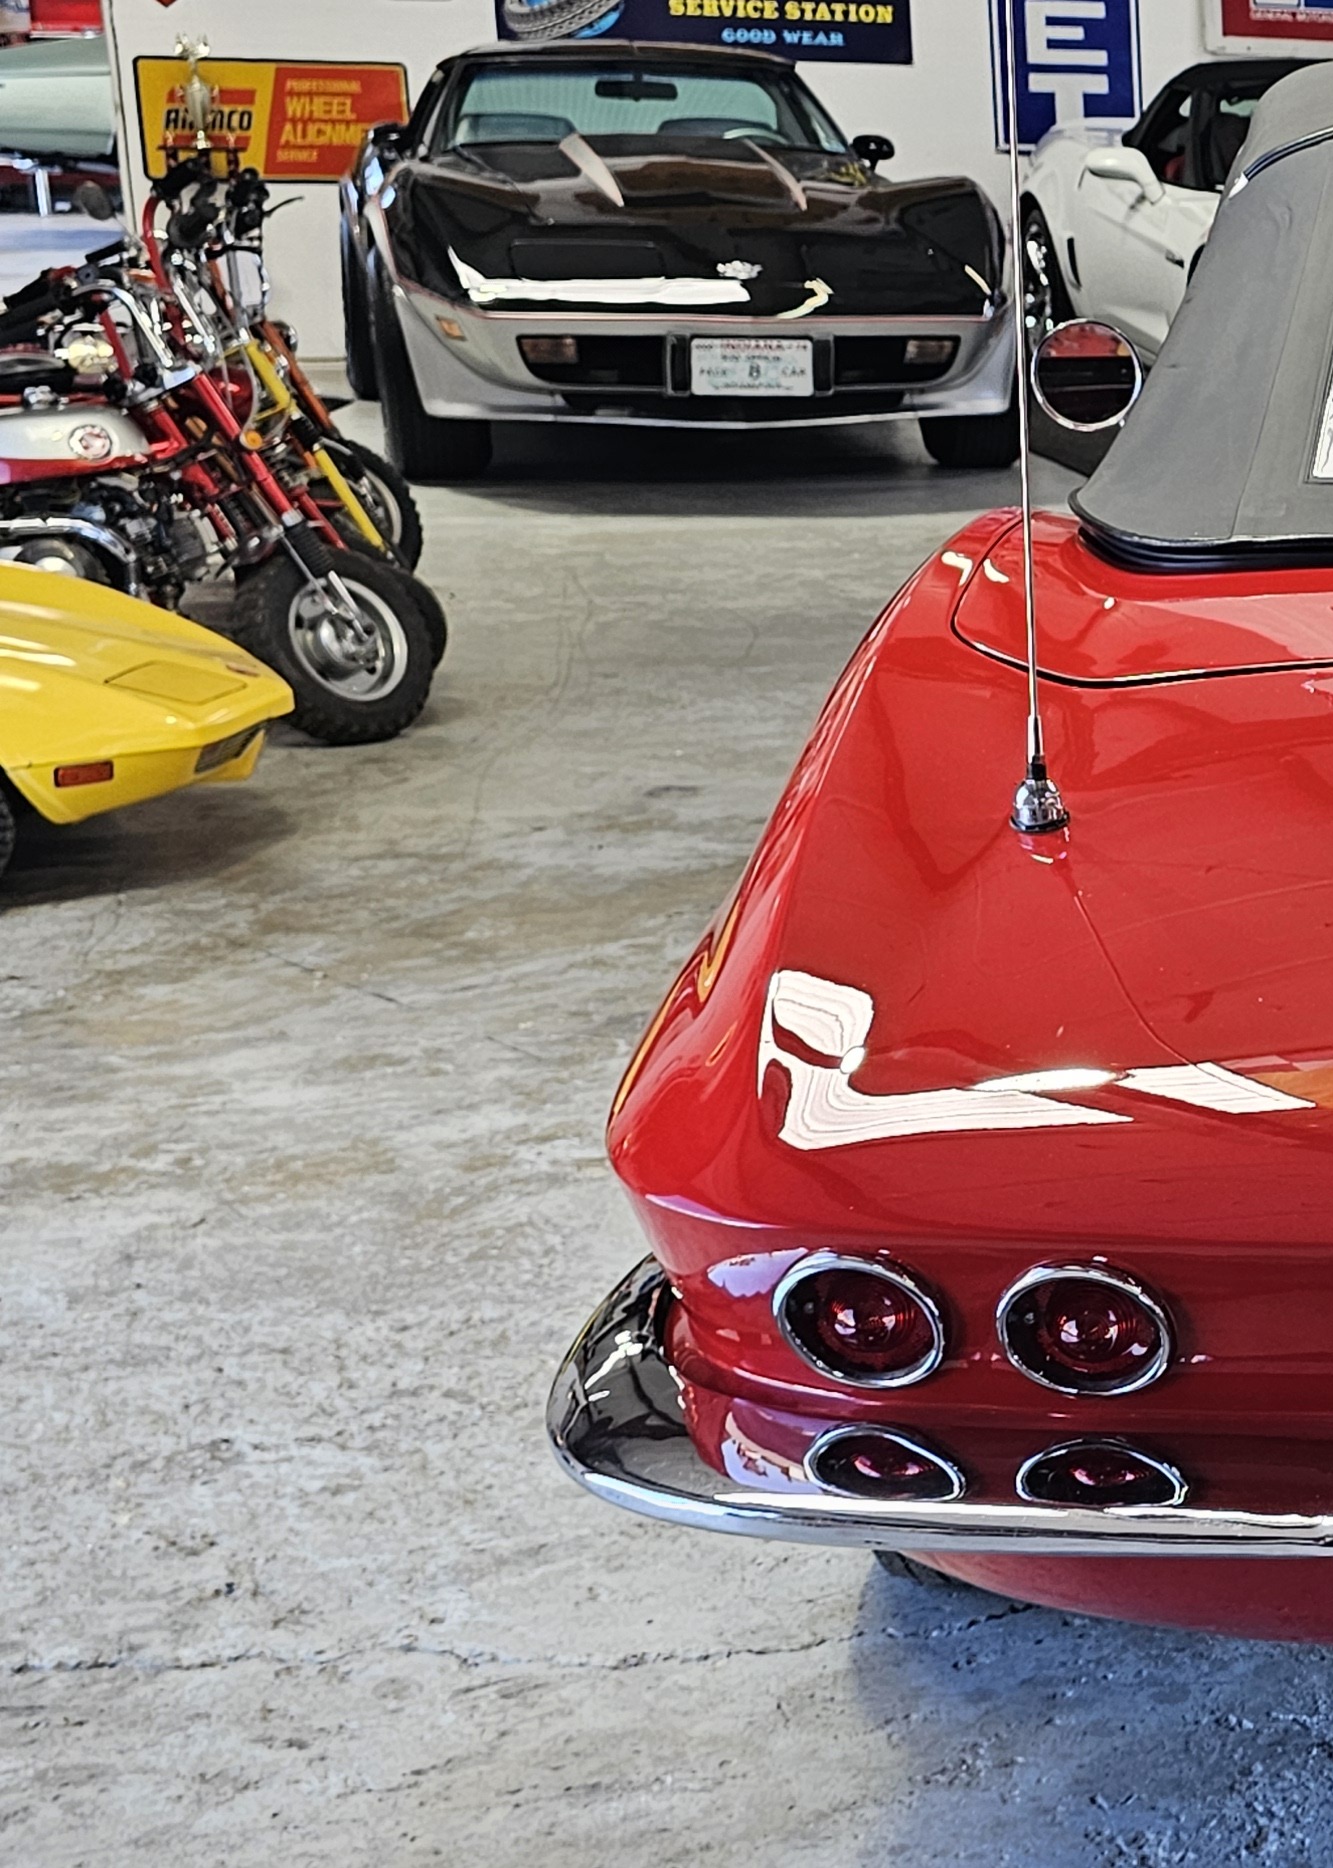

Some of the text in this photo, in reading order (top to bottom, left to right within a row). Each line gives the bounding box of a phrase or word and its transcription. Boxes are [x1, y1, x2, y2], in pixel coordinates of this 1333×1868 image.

[669, 0, 894, 23] SERVICE STATION
[721, 27, 844, 46] GOOD WEAR
[285, 95, 357, 119] WHEEL
